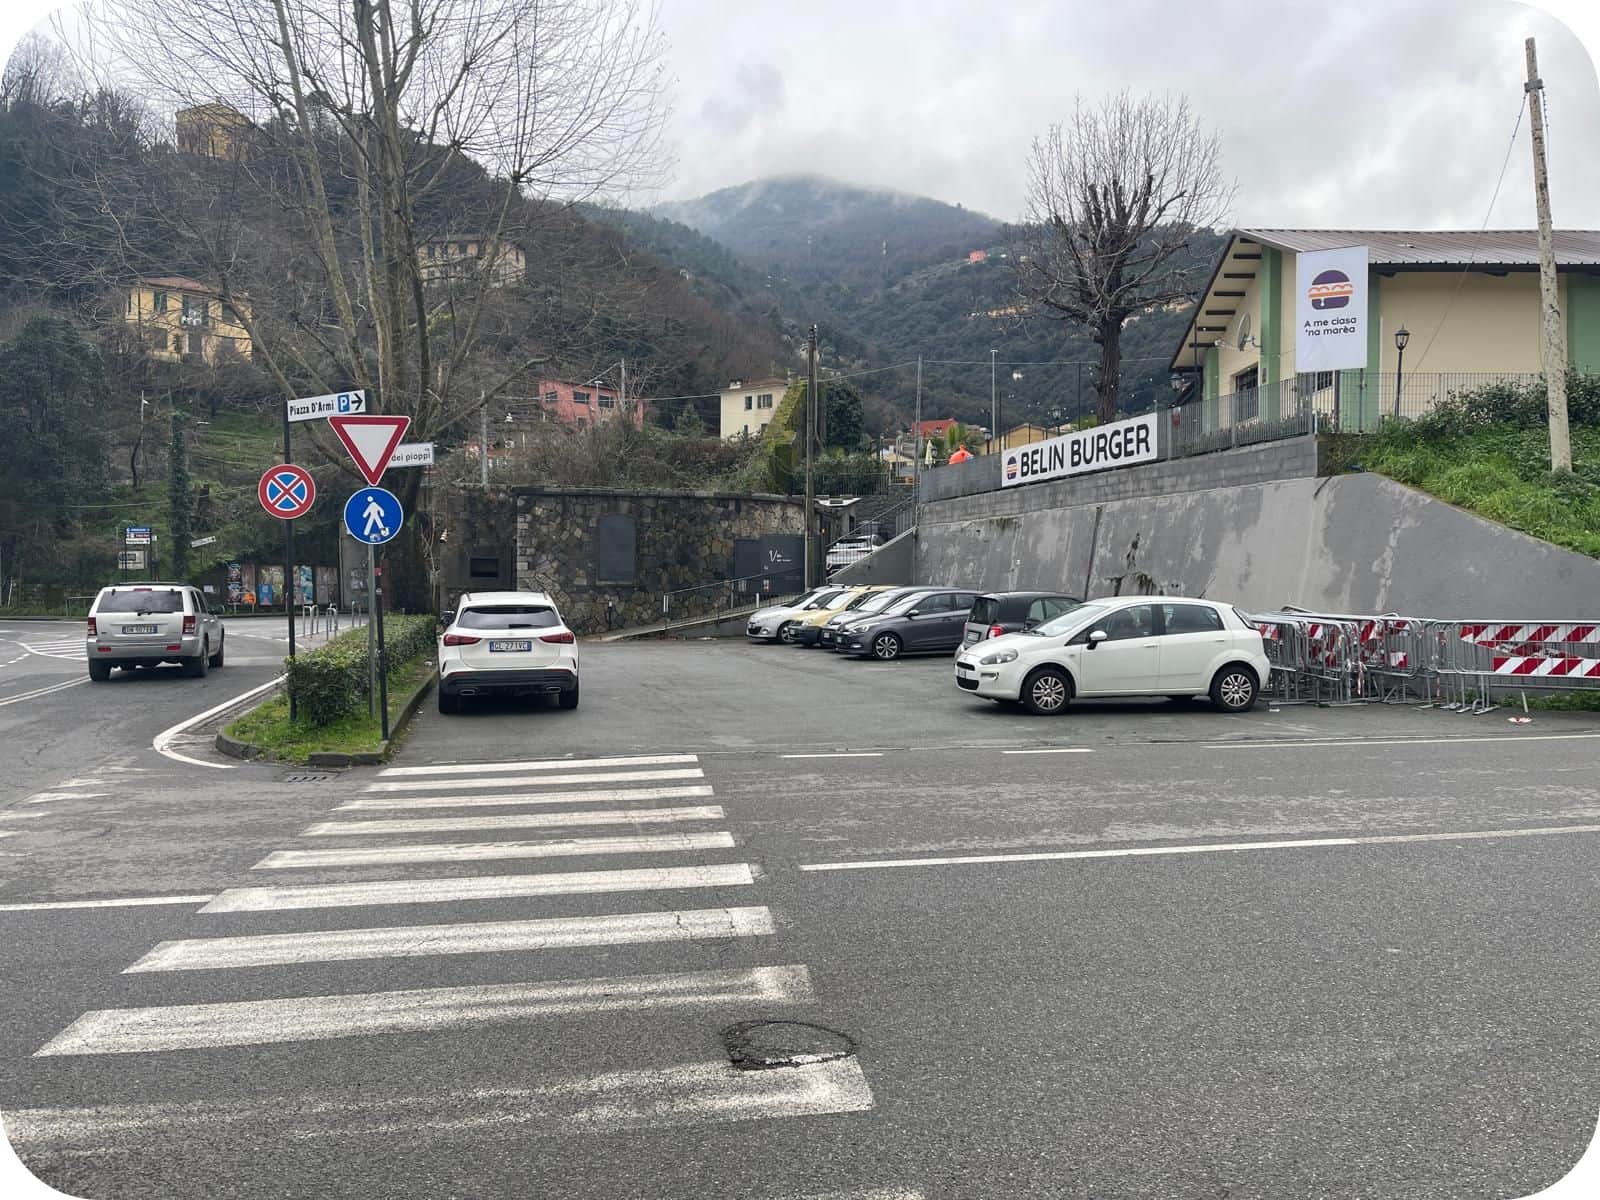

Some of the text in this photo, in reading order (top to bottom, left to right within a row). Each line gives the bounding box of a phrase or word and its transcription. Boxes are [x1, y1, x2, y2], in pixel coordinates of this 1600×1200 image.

[1331, 316, 1357, 325] ciasa
[290, 404, 309, 417] Piazza
[311, 400, 334, 413] D'Armi
[1021, 423, 1150, 477] BELIN BURGER
[406, 452, 431, 463] pioppi
